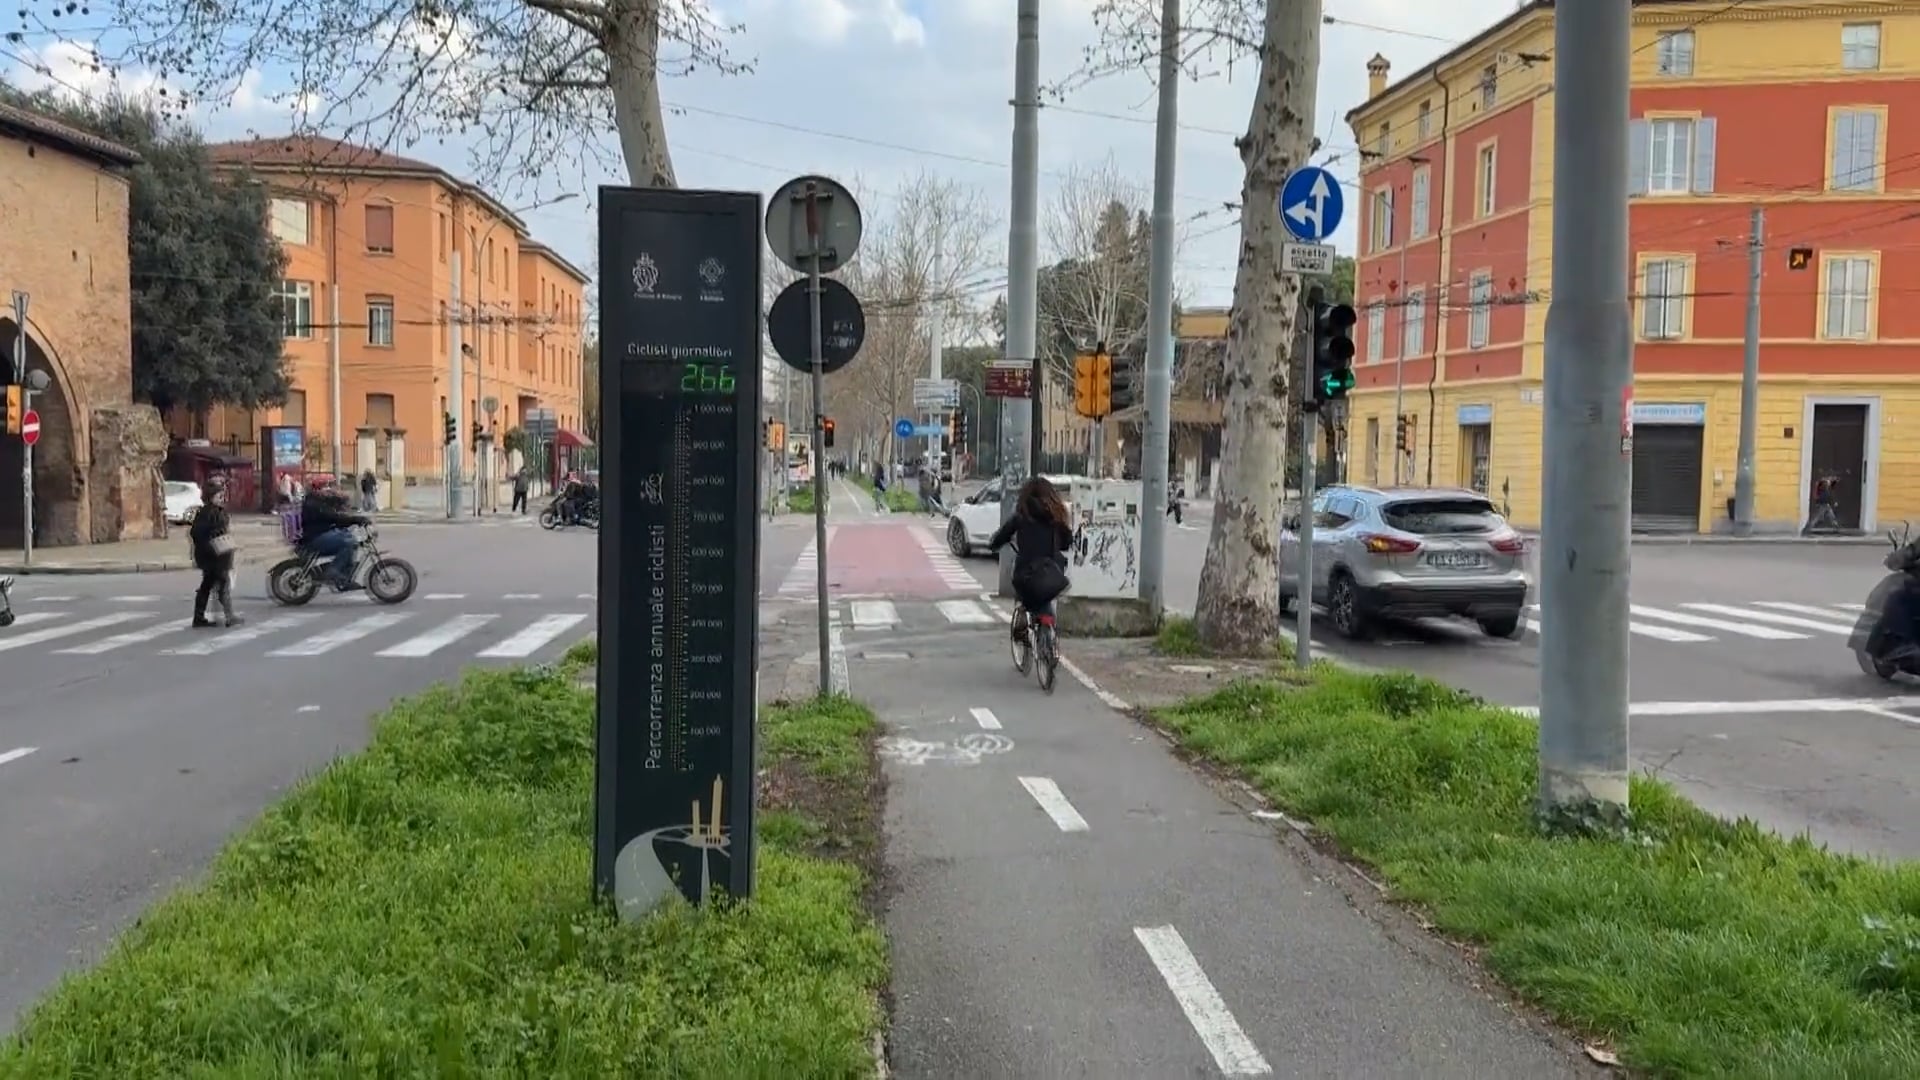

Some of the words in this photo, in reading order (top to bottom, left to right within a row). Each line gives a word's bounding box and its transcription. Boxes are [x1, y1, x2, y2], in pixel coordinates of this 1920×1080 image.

[627, 342, 668, 356] Ciclisti
[680, 363, 736, 394] 266
[647, 523, 665, 581] ciclisti
[646, 587, 665, 658] annuale
[644, 662, 664, 770] Percorrenza
